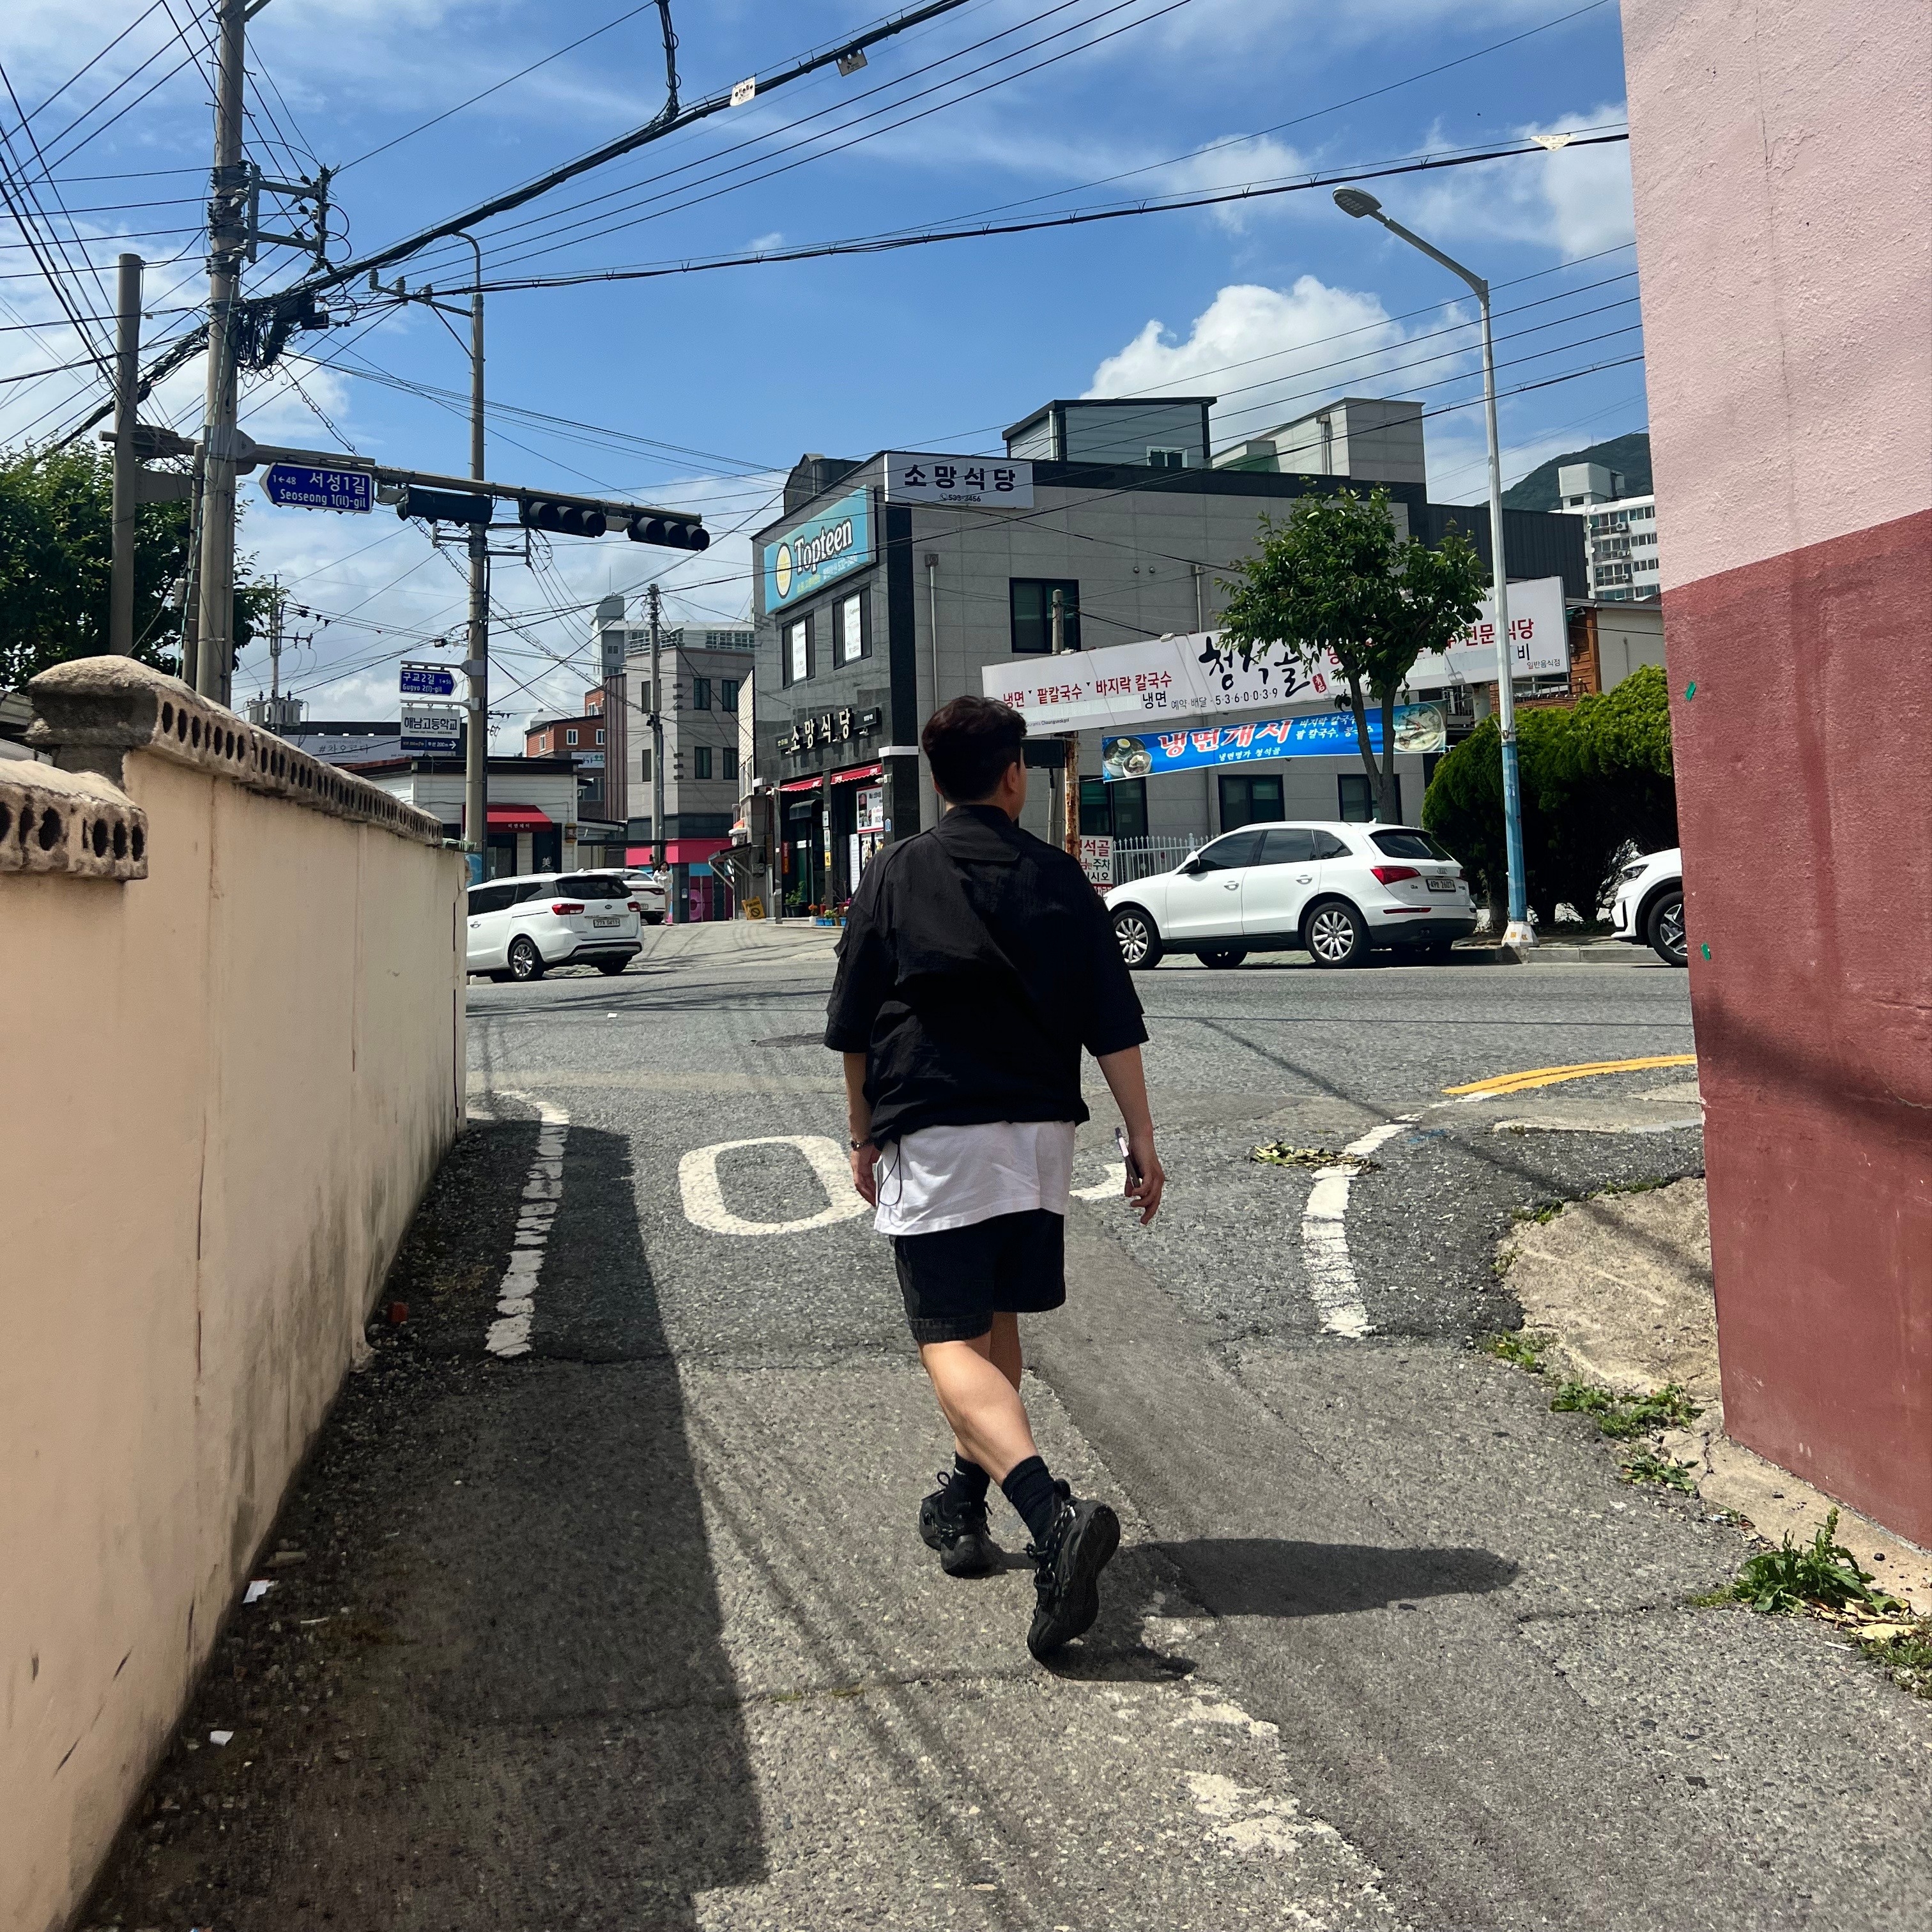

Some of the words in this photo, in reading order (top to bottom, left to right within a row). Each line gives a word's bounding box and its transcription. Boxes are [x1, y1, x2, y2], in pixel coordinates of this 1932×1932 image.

[309, 472, 365, 495] 서성1길
[905, 464, 1016, 492] 소망식당
[280, 489, 327, 505] Seoseong
[331, 494, 366, 509] 1(il)-gil
[794, 519, 853, 576] Topteen
[1526, 658, 1561, 670] 일반음식점
[403, 672, 434, 685] 구교2길
[1003, 690, 1025, 709] 냉면
[1037, 683, 1083, 705] 팥칼국수
[1096, 676, 1131, 696] 바지락
[1135, 671, 1172, 692] 칼국수
[1142, 690, 1167, 709] 냉면
[404, 716, 457, 730] 해남고등학교
[791, 708, 850, 751] 소망식당
[1300, 716, 1328, 728] 바지락
[1331, 714, 1356, 726] 칼국수
[1158, 719, 1294, 758] 냉면개시
[1219, 749, 1252, 762] 냉면명가
[1255, 746, 1282, 758] 청석골
[1093, 858, 1110, 871] 주차
[1087, 871, 1110, 882] 시오
